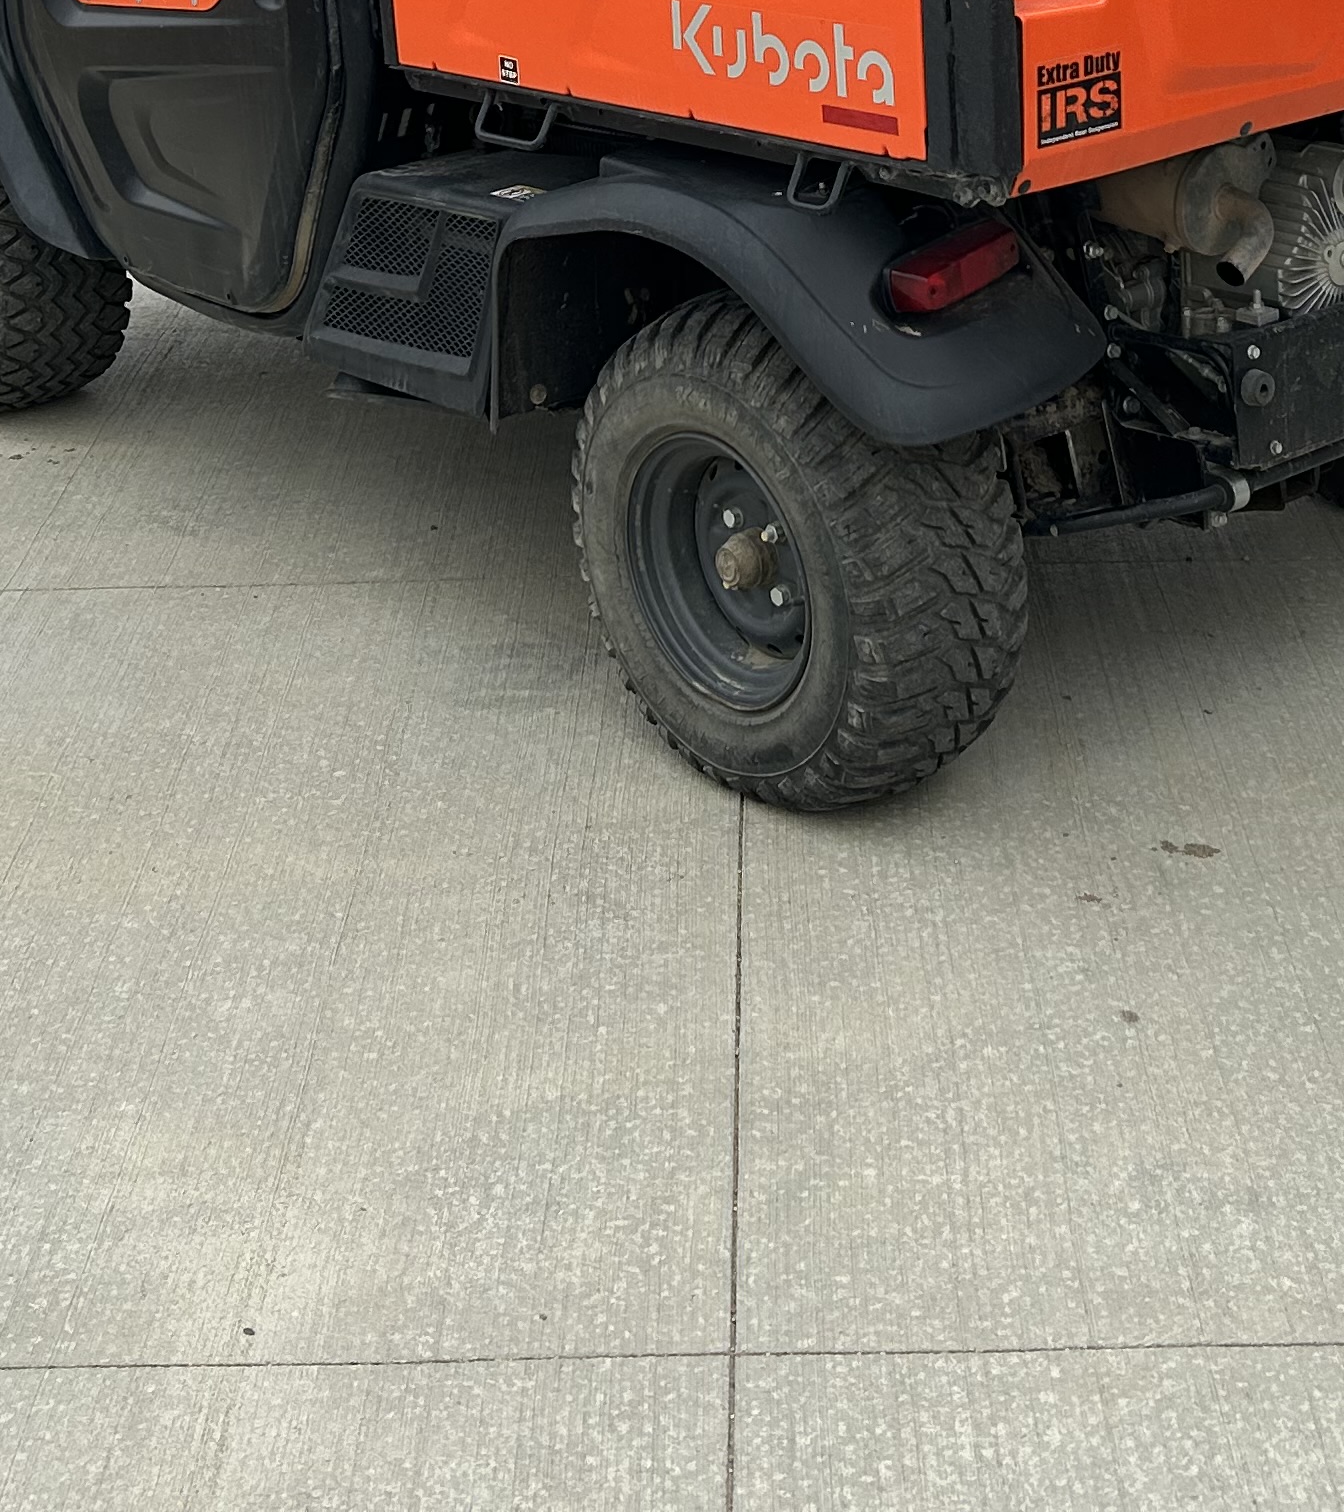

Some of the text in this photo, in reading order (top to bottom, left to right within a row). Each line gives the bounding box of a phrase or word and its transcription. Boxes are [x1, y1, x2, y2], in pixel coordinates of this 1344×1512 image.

[671, 0, 895, 106] Kubota
[1037, 50, 1121, 87] Extra Duty
[1040, 80, 1119, 133] IRS
